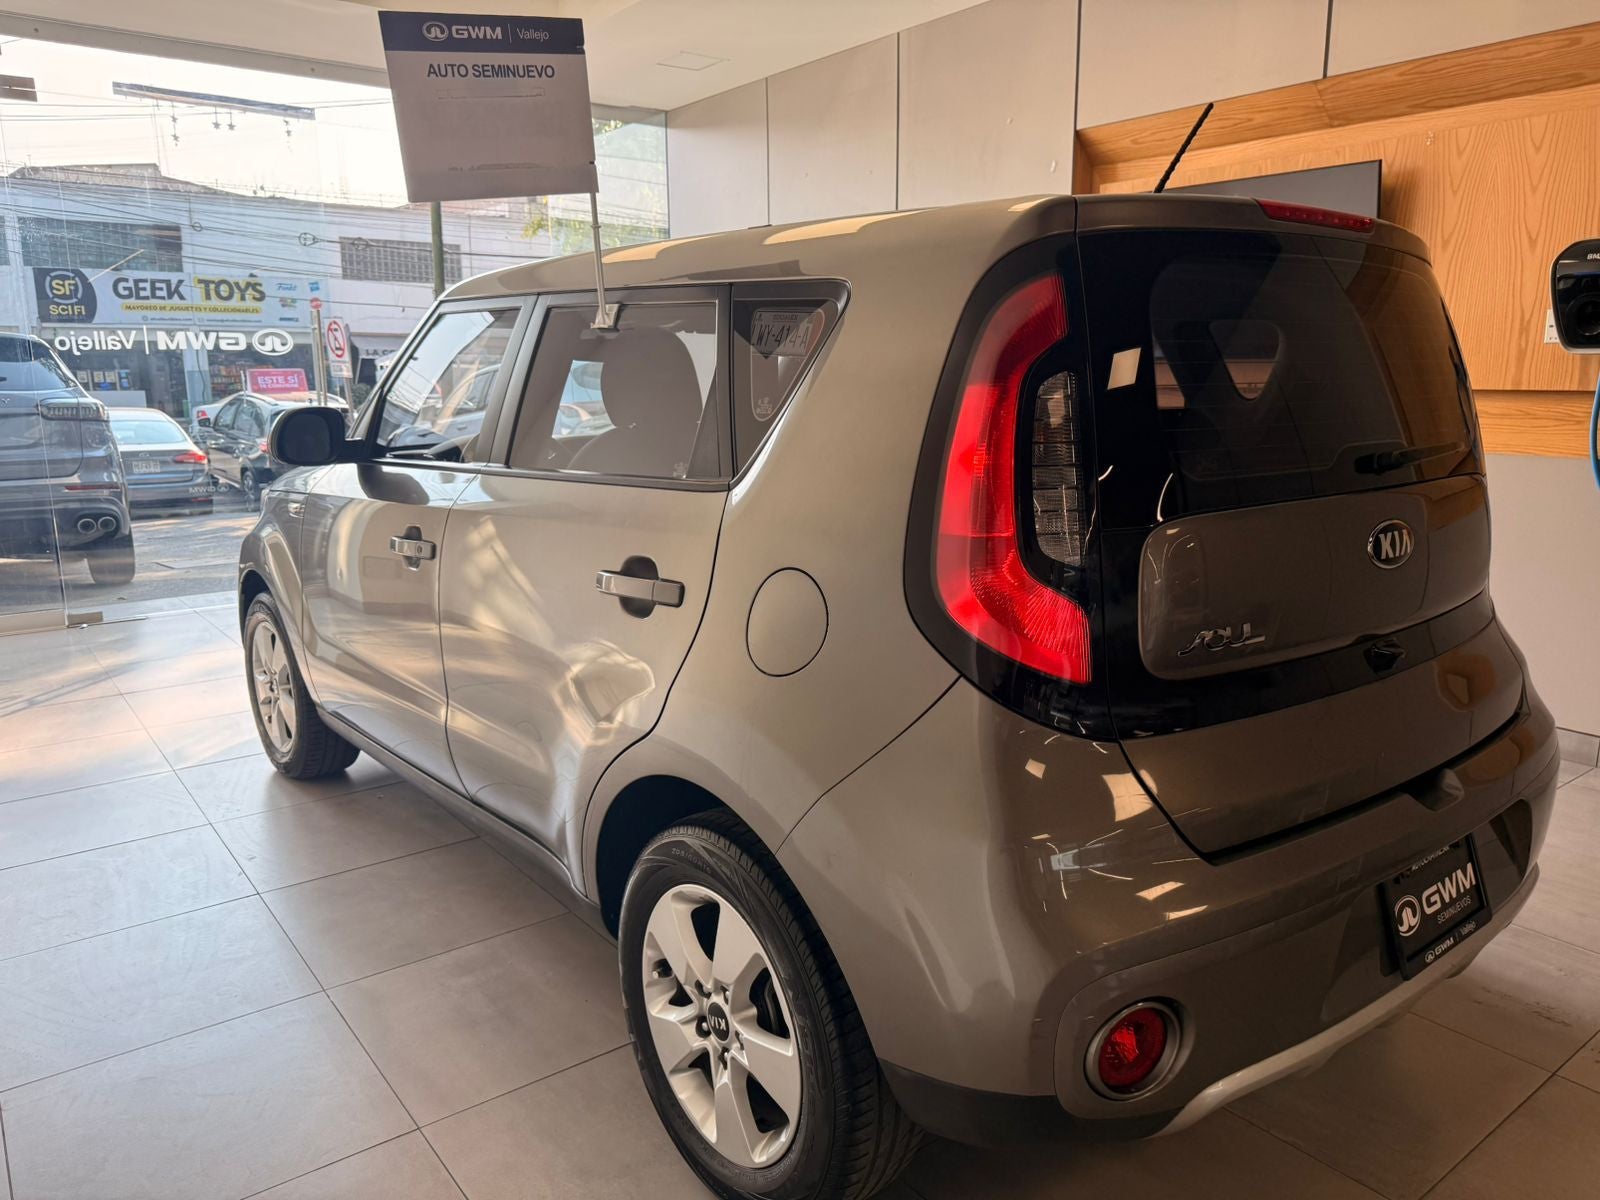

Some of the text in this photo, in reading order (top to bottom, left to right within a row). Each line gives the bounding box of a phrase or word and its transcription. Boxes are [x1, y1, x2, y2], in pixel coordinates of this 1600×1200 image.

[451, 25, 550, 42] GWM Vallejo
[427, 63, 555, 79] AUTO SEMINUEVO
[51, 279, 76, 295] SF
[112, 277, 266, 302] GEEK TOYS
[49, 304, 86, 315] SCI FI
[257, 375, 286, 385] ESTE
[1379, 528, 1412, 560] KIA
[1422, 861, 1477, 915] GWM
[1434, 936, 1455, 955] GWM
[709, 1015, 727, 1031] KIA
